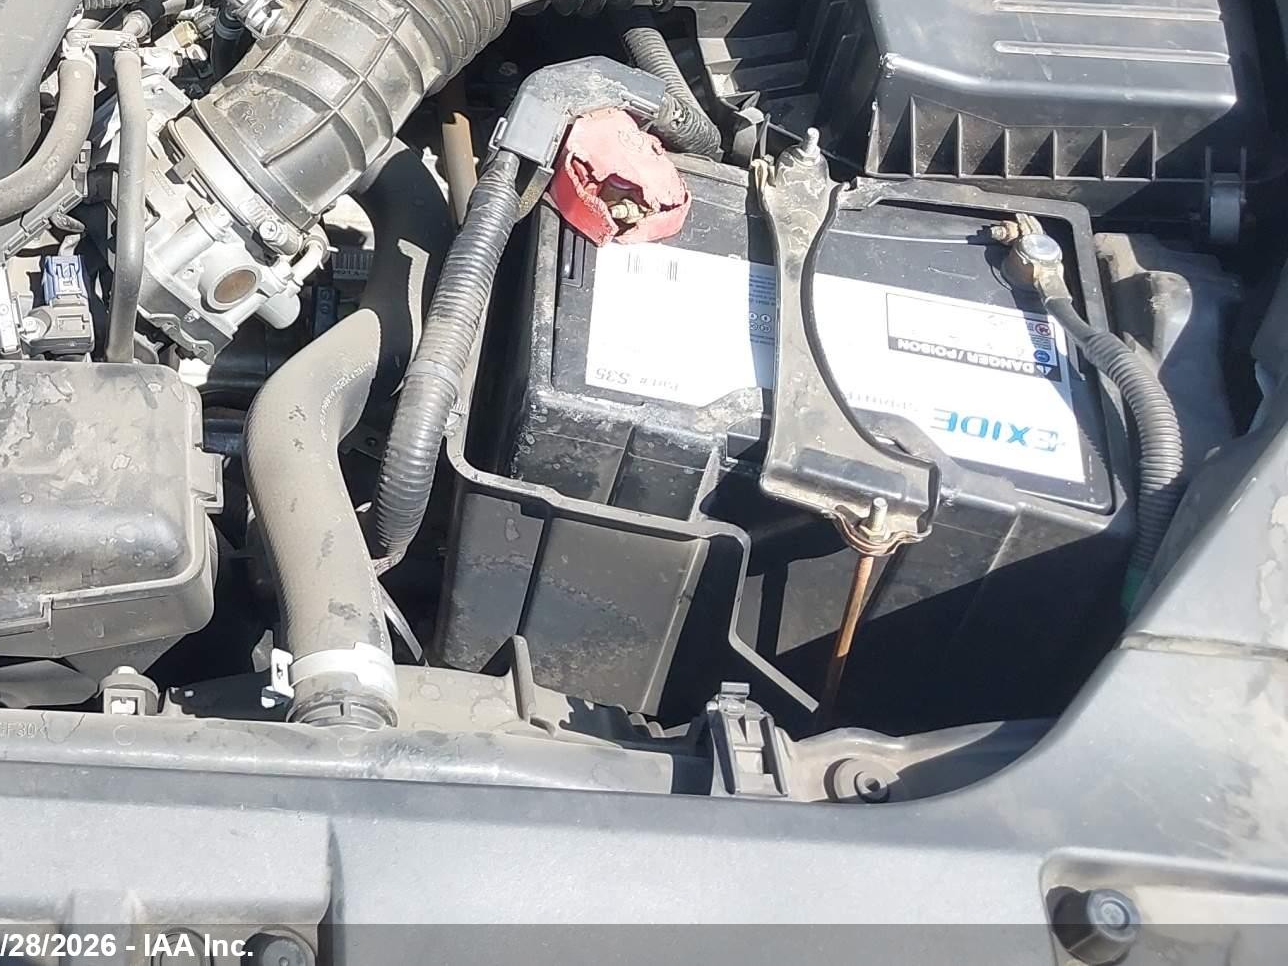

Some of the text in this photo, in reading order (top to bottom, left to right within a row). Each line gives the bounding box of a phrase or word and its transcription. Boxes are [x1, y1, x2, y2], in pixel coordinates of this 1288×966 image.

[896, 338, 958, 358] POISON
[965, 350, 1036, 374] DANGER
[594, 368, 630, 385] S35
[930, 407, 1059, 454] EXIDE
